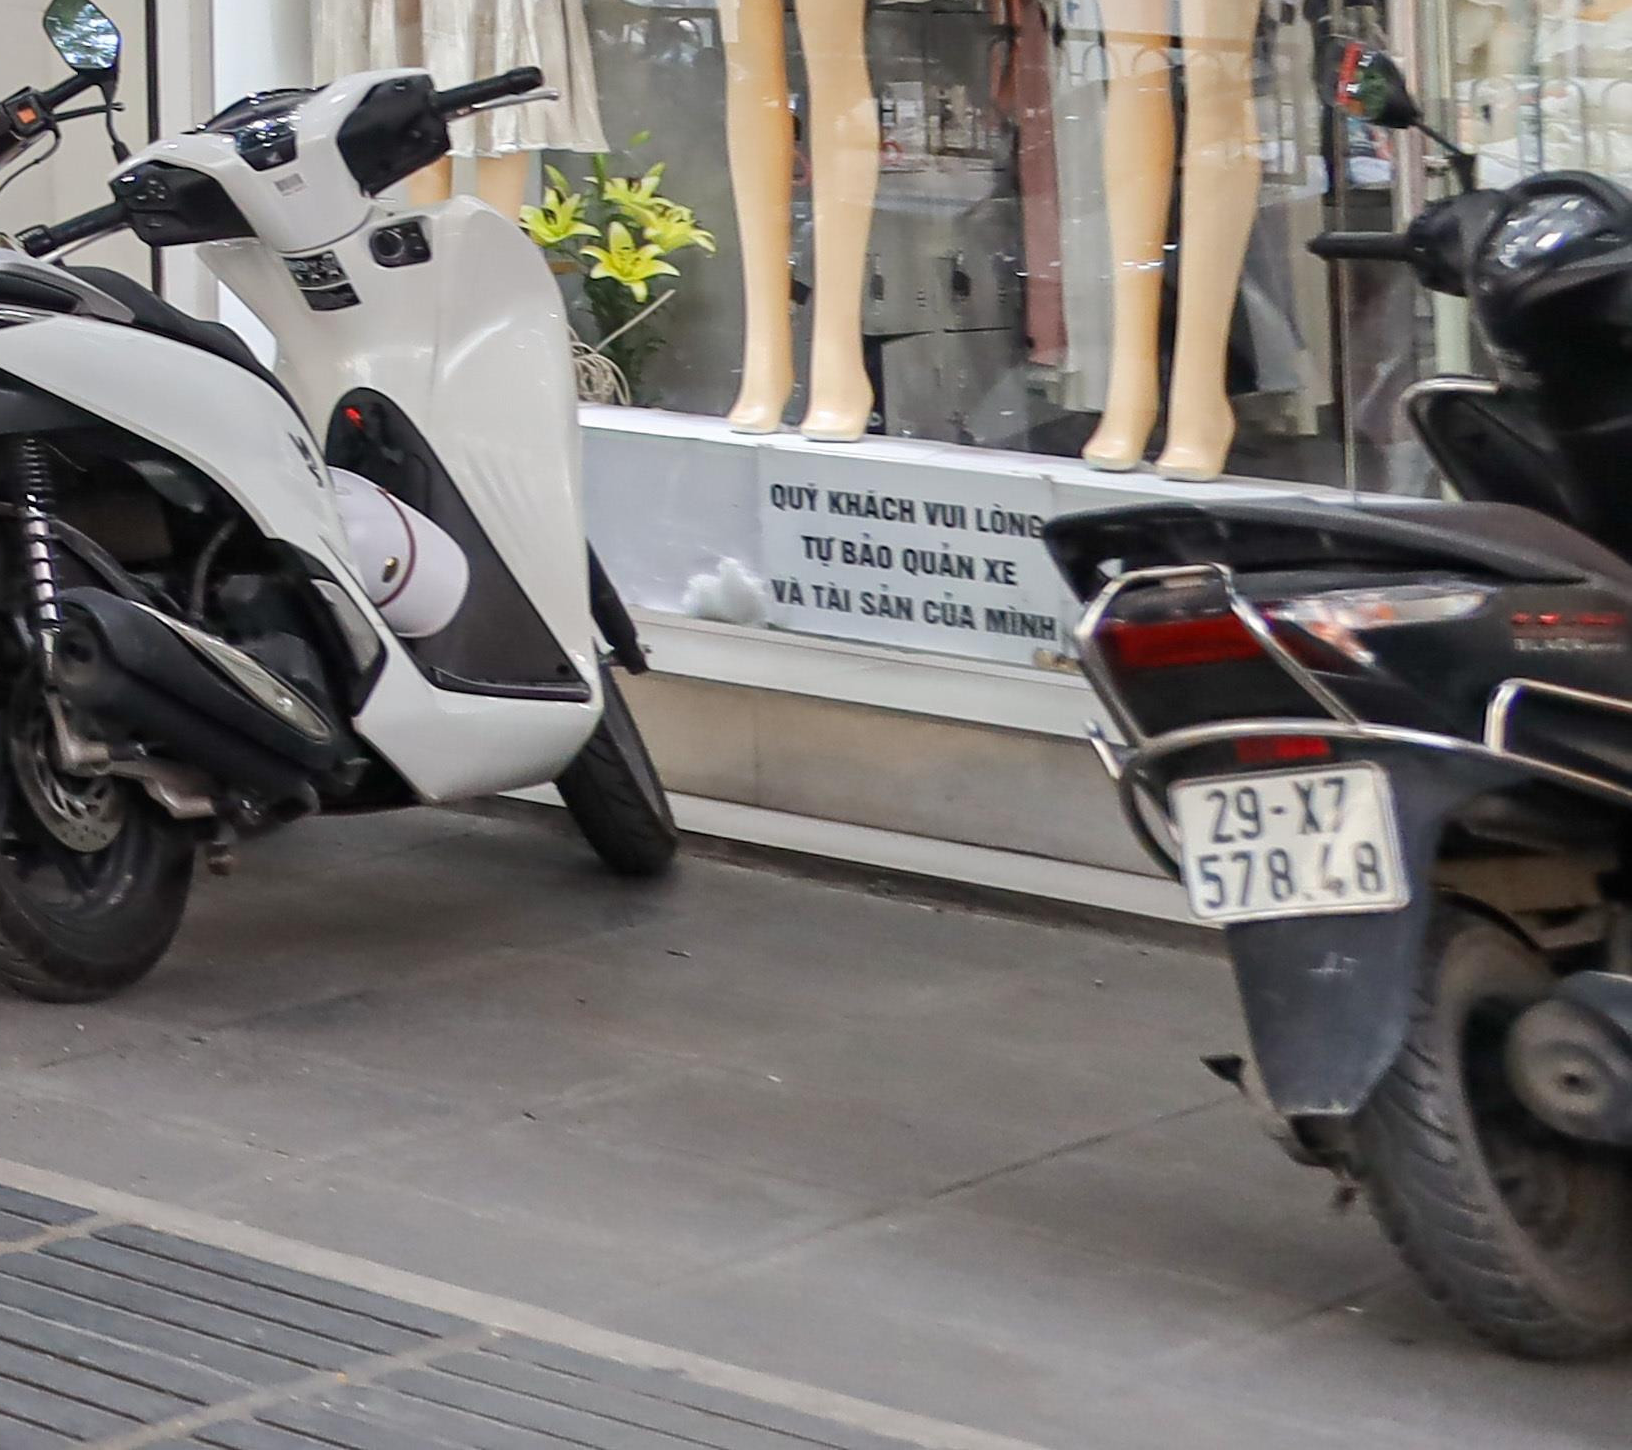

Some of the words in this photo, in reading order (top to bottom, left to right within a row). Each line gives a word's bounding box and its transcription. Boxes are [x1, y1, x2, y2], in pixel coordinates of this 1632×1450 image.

[770, 481, 819, 512] QUÝ
[828, 490, 916, 525] KHÁCH
[926, 501, 966, 530] VUI
[975, 500, 1045, 539] LÒNG
[801, 533, 837, 568] TỰ
[842, 533, 892, 569] BẢO
[903, 541, 975, 581] QUẢN
[983, 556, 1018, 587] XE
[770, 578, 804, 608] VÀ
[812, 579, 851, 614] TÀI
[860, 583, 914, 624] SẢN
[926, 590, 975, 632] CỦA
[985, 598, 1057, 641] MÌNH
[1207, 776, 1345, 844] 29-X7
